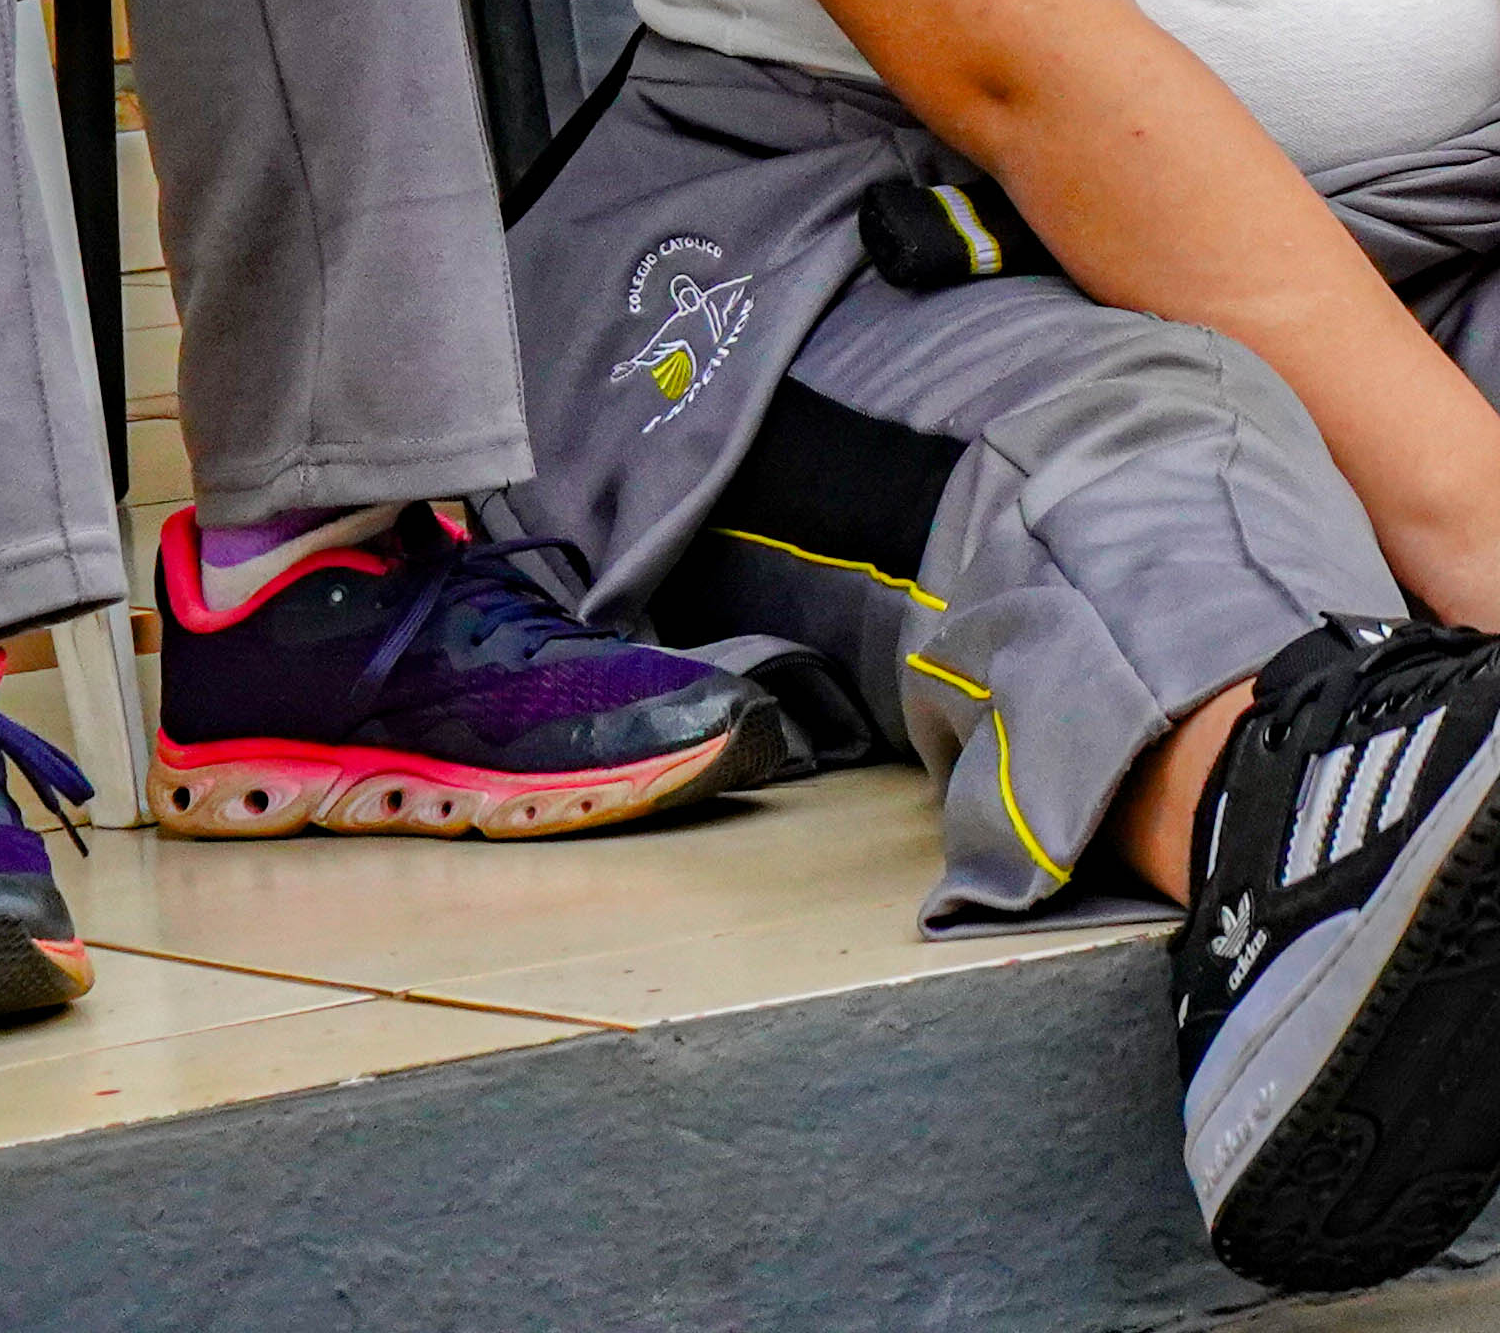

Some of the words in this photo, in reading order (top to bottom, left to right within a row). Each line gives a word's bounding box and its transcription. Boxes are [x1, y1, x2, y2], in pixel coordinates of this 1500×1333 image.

[628, 252, 658, 313] COLEGIO
[659, 236, 723, 259] CATOLICO
[1228, 929, 1268, 991] adidas
